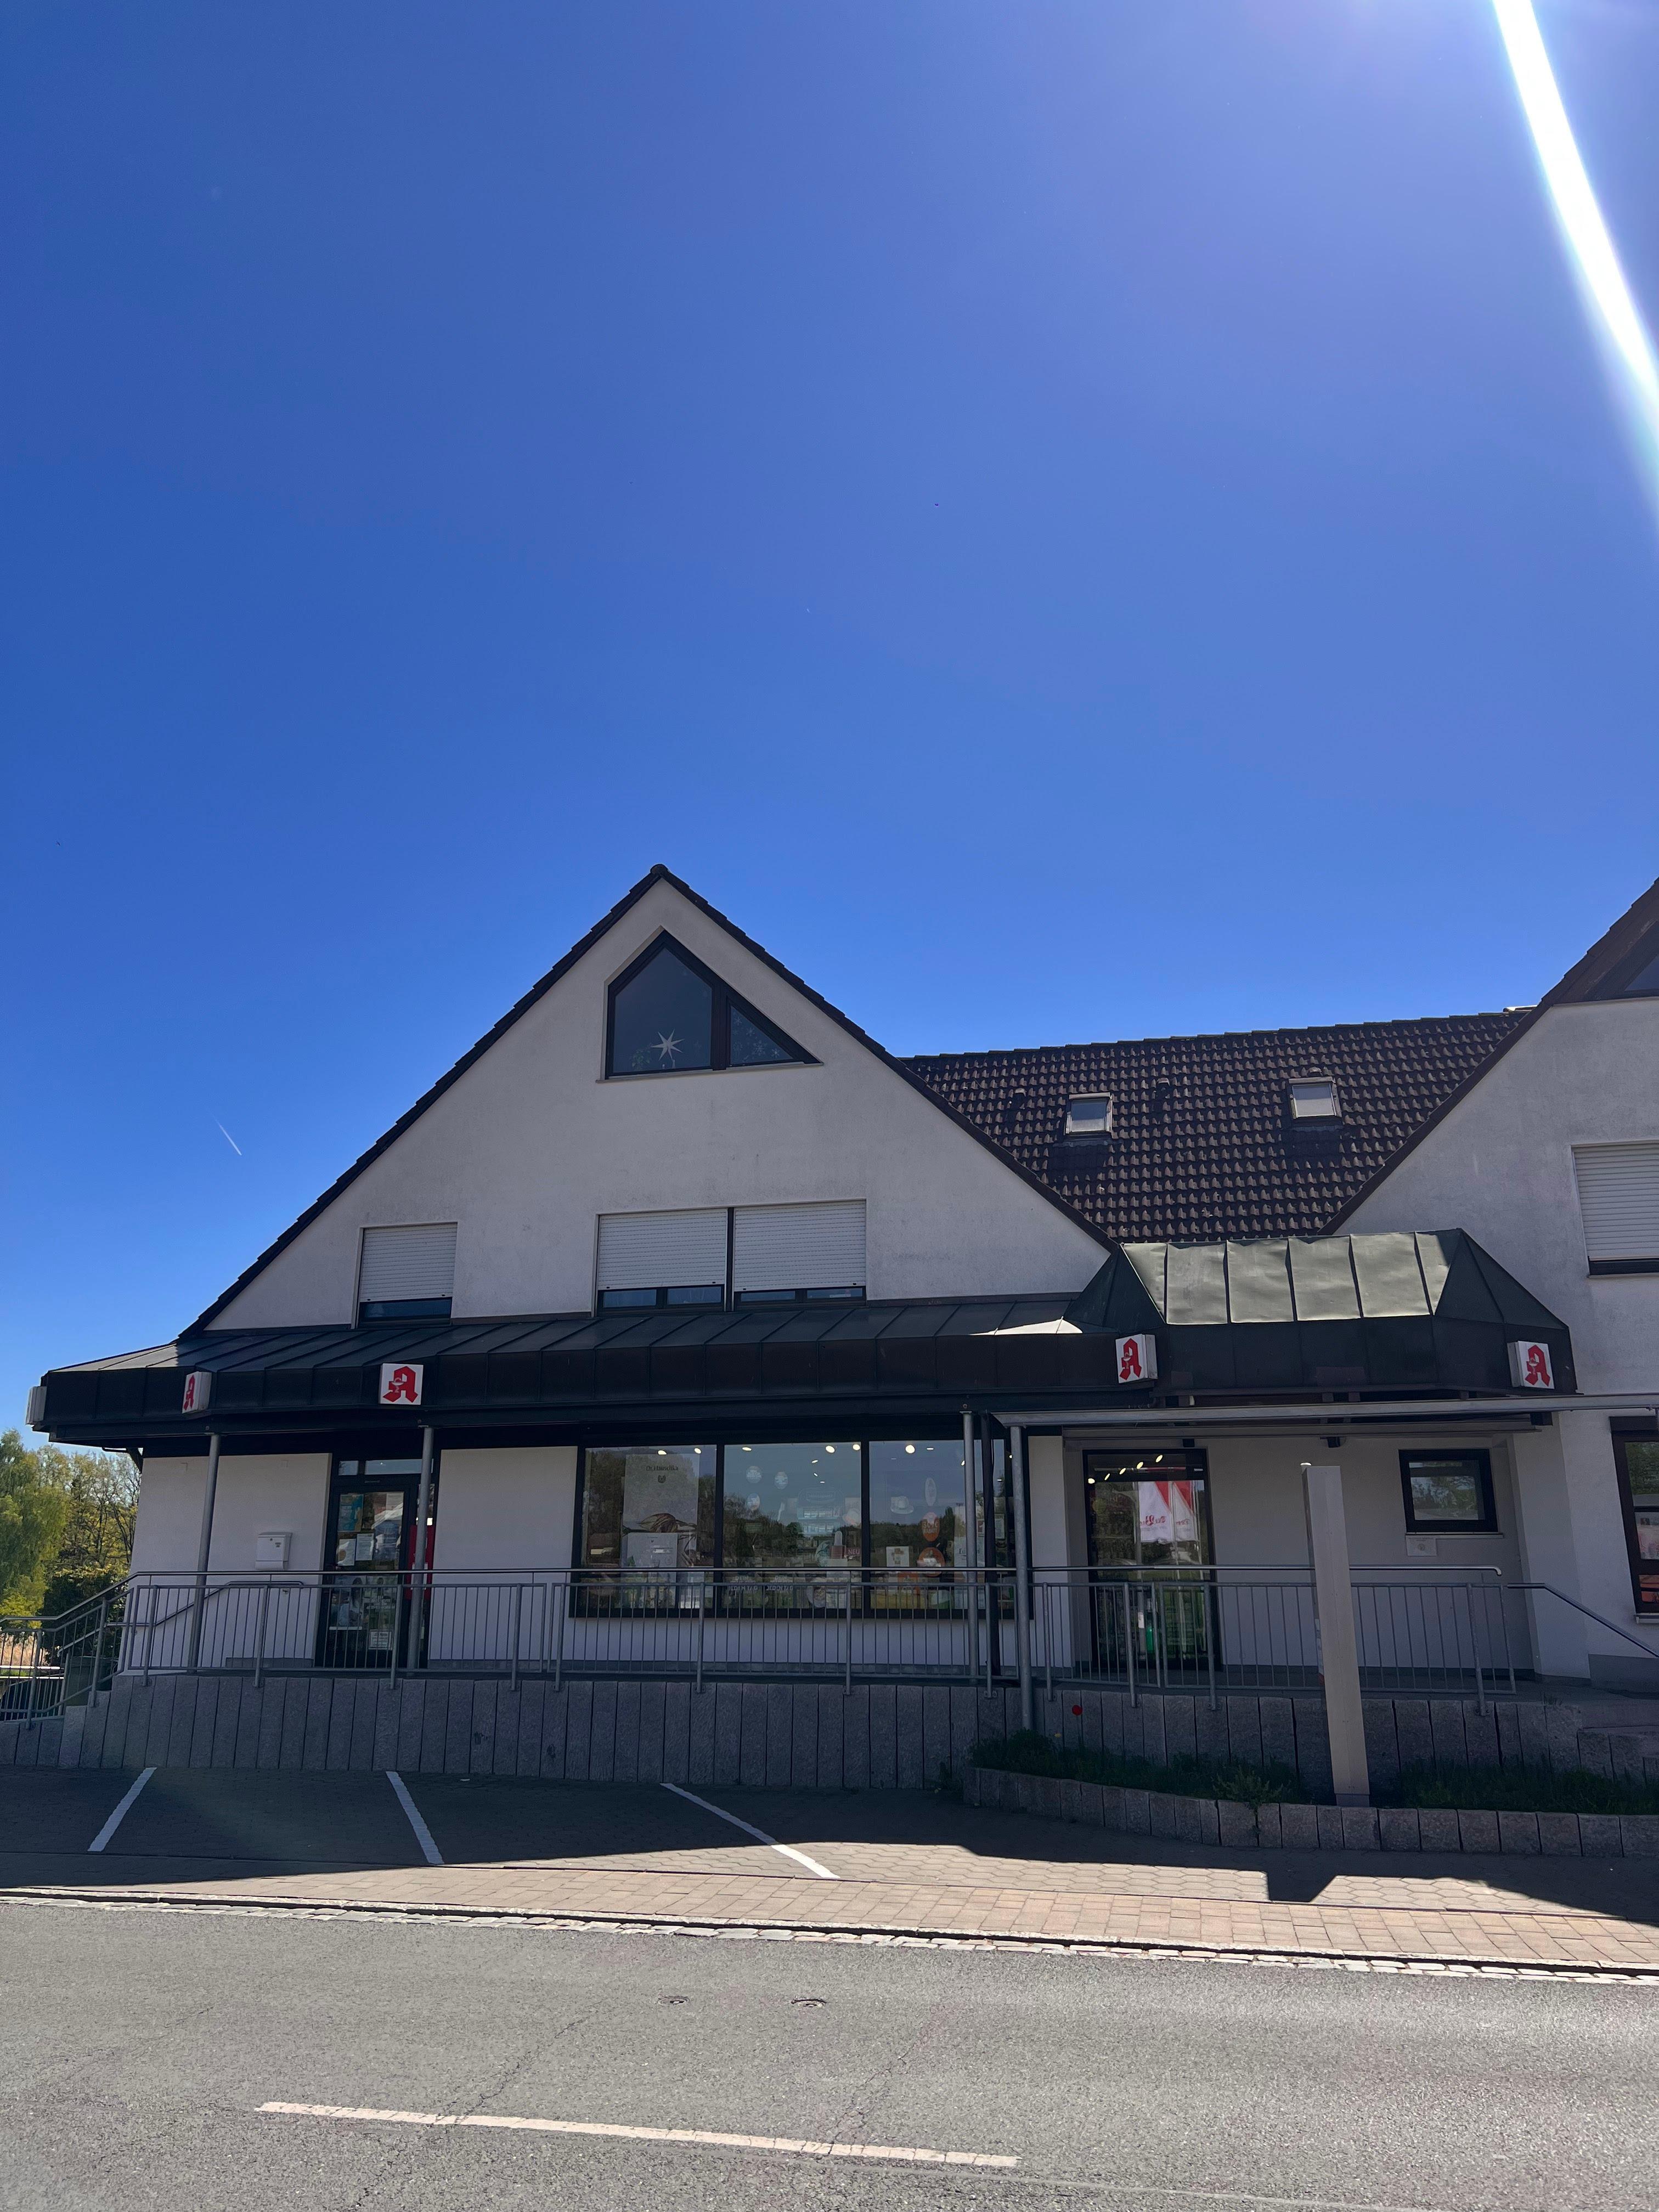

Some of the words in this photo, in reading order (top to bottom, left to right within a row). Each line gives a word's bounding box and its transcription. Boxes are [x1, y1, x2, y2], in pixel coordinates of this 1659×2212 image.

[1119, 1338, 1142, 1380] A
[1525, 1344, 1551, 1387] A
[382, 1365, 419, 1403] A
